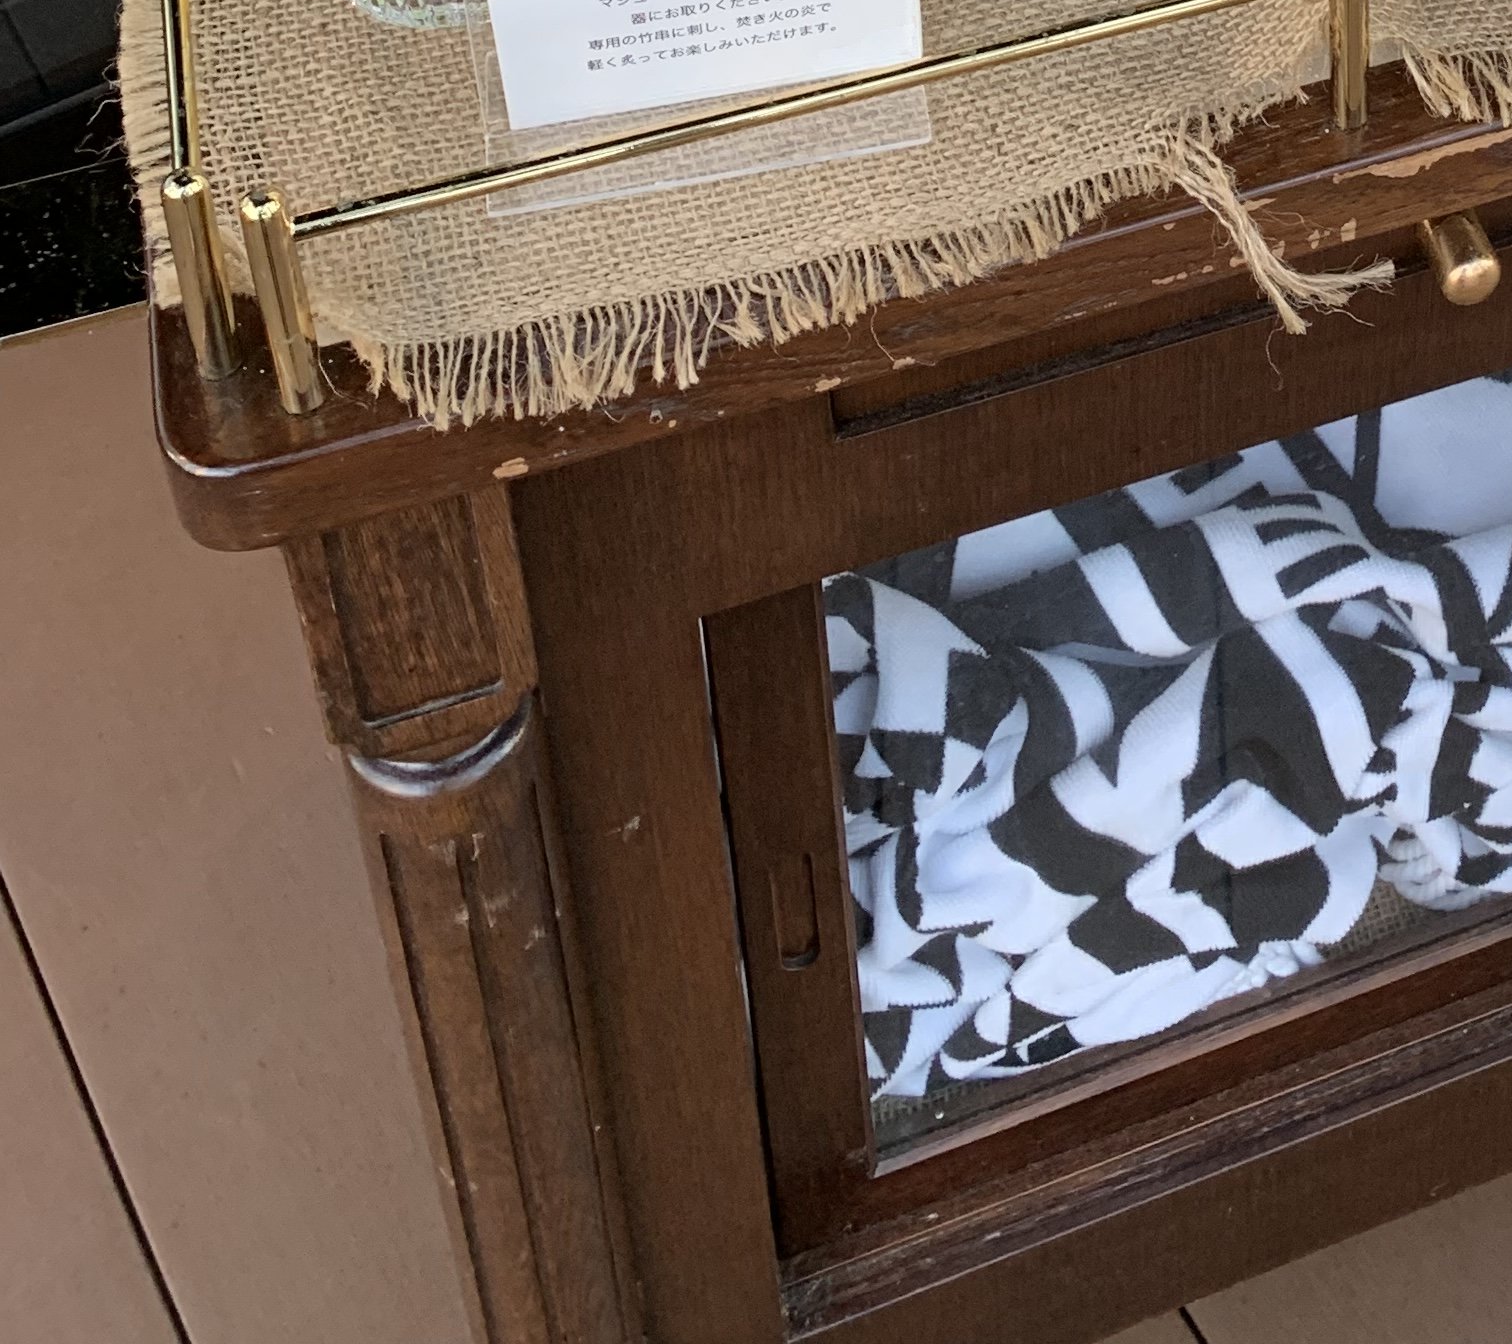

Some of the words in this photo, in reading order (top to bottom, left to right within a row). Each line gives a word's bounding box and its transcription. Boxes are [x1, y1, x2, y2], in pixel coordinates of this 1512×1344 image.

[587, 21, 838, 72] 軽く炙ってお楽しみいただけます。
